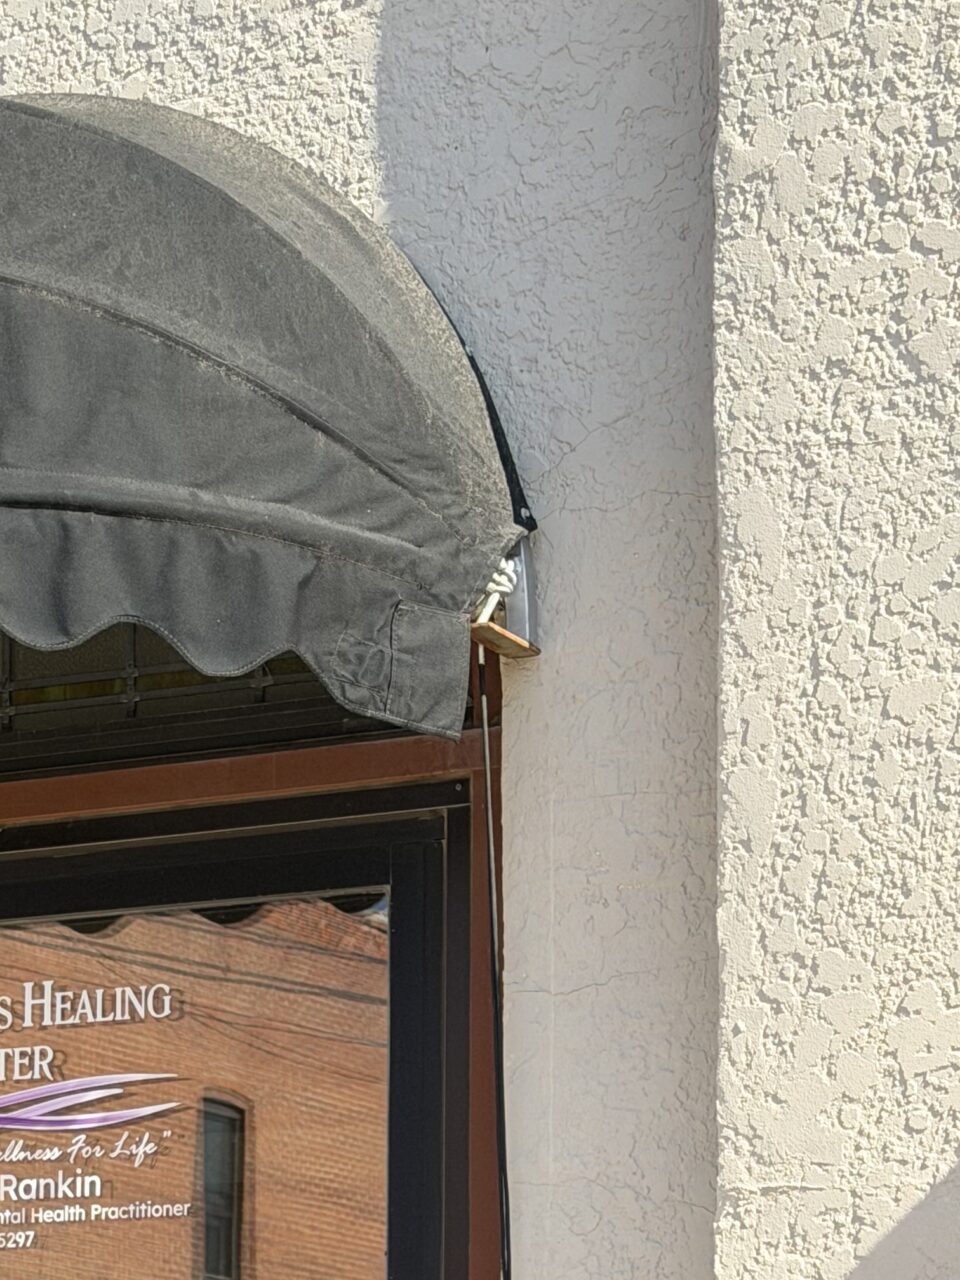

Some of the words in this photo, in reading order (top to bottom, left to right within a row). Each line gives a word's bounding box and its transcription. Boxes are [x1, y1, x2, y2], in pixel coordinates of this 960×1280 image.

[22, 980, 172, 1027] HEALING
[67, 1134, 104, 1163] For
[0, 1168, 101, 1201] Rankin
[31, 1204, 86, 1224] Health
[90, 1200, 191, 1221] Practitioner
